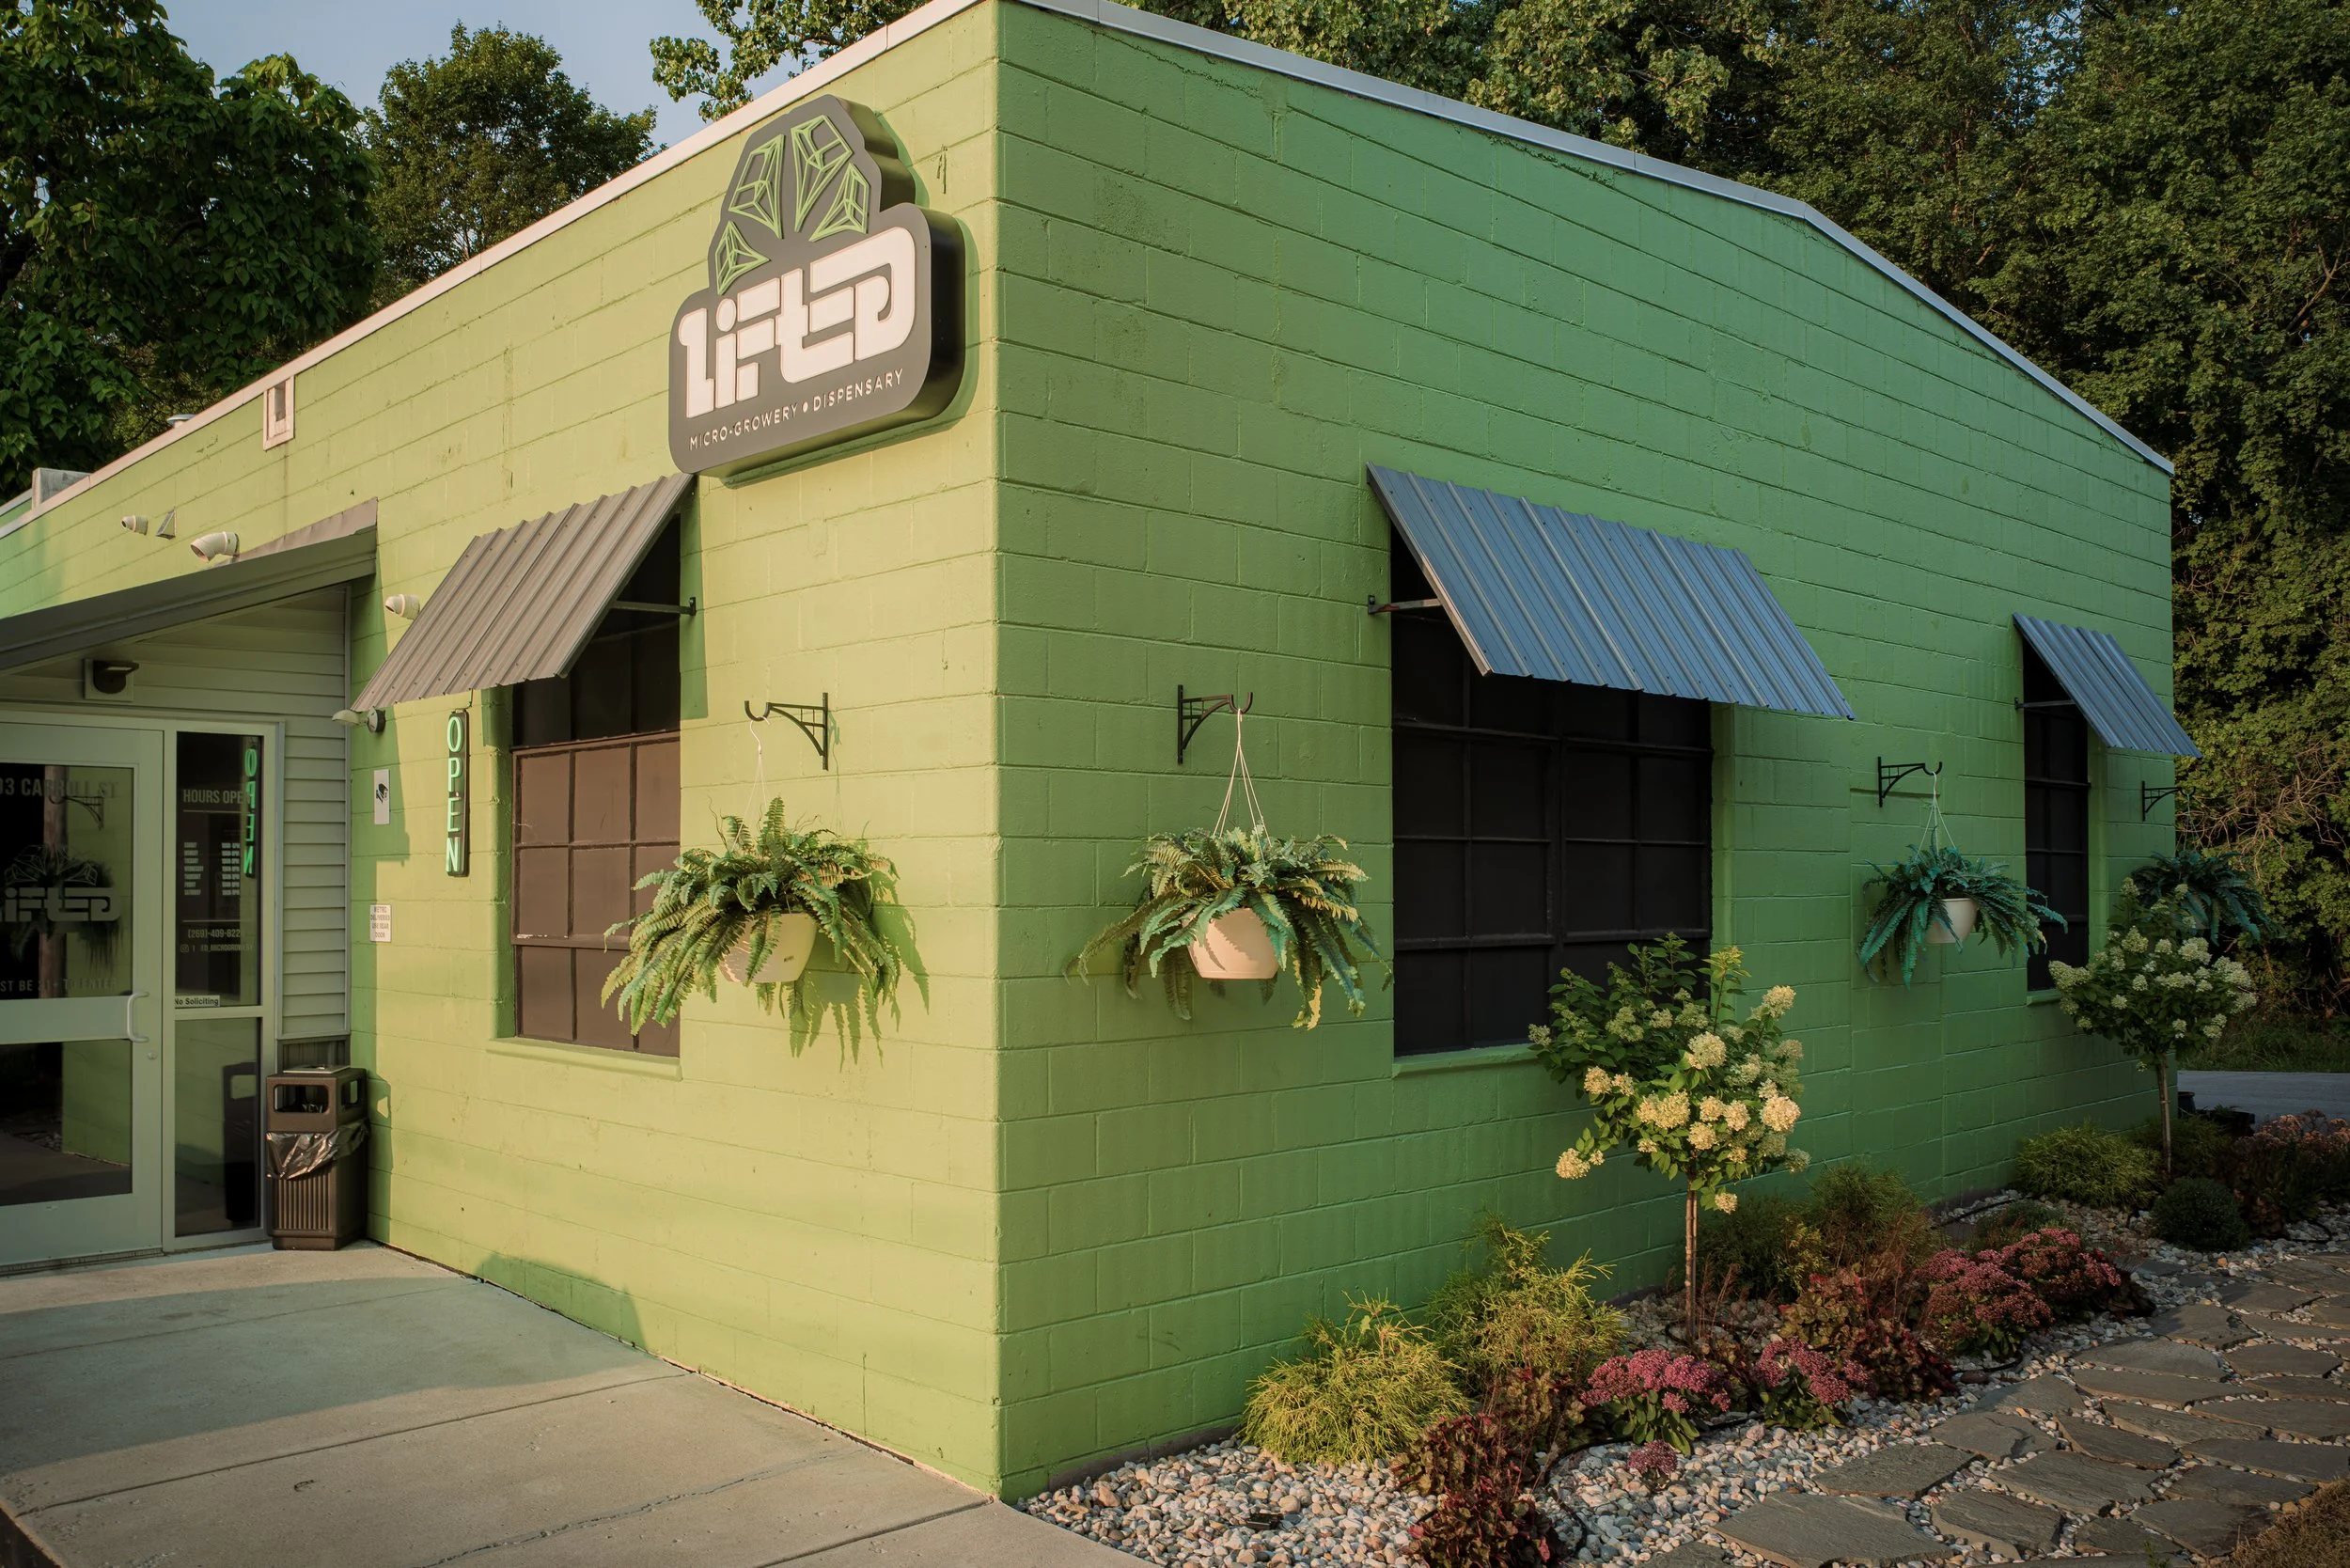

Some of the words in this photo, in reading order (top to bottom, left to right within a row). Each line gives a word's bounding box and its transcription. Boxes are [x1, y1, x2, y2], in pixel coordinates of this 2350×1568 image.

[689, 404, 798, 450] MICRO-GROWERY
[812, 368, 903, 412] DISPENSARY
[183, 790, 220, 804] HOURS
[446, 716, 463, 872] OPEN
[19, 980, 34, 992] BE
[186, 996, 219, 1006] Soliciting
